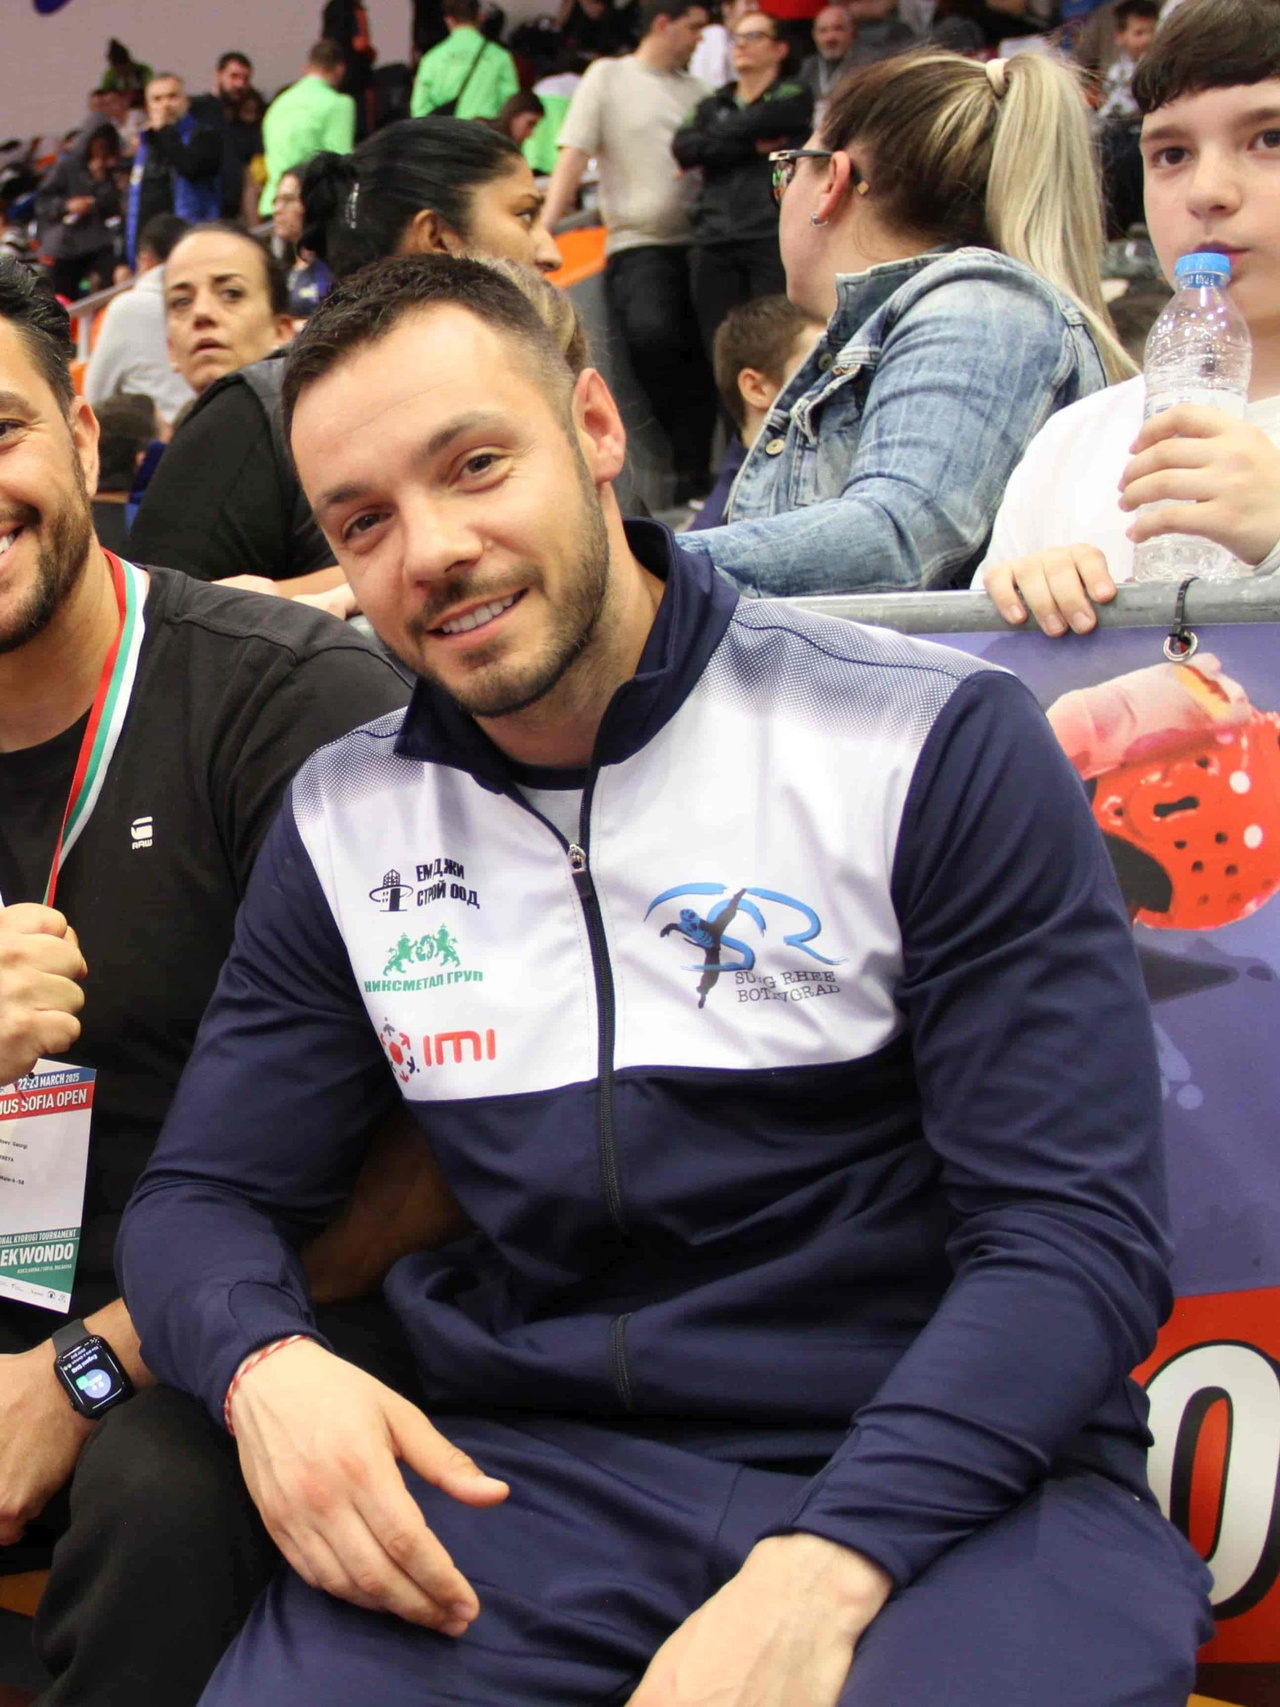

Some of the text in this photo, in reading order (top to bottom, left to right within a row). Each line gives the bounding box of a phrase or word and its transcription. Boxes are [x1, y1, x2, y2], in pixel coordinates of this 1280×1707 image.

[132, 839, 153, 850] RAW
[415, 857, 465, 882] ЕМДЖИ
[416, 879, 480, 910] СТРОЙ ООД
[364, 970, 484, 993] НИКСМЕТАЛ ГРУП
[781, 970, 836, 986] RHEE
[17, 1077, 39, 1091] 22-23
[40, 1073, 65, 1087] MARCH
[66, 1072, 81, 1083] 2025
[21, 1092, 54, 1113] SOFIA
[56, 1088, 87, 1107] OPEN
[39, 1229, 76, 1241] TOURNAMENT
